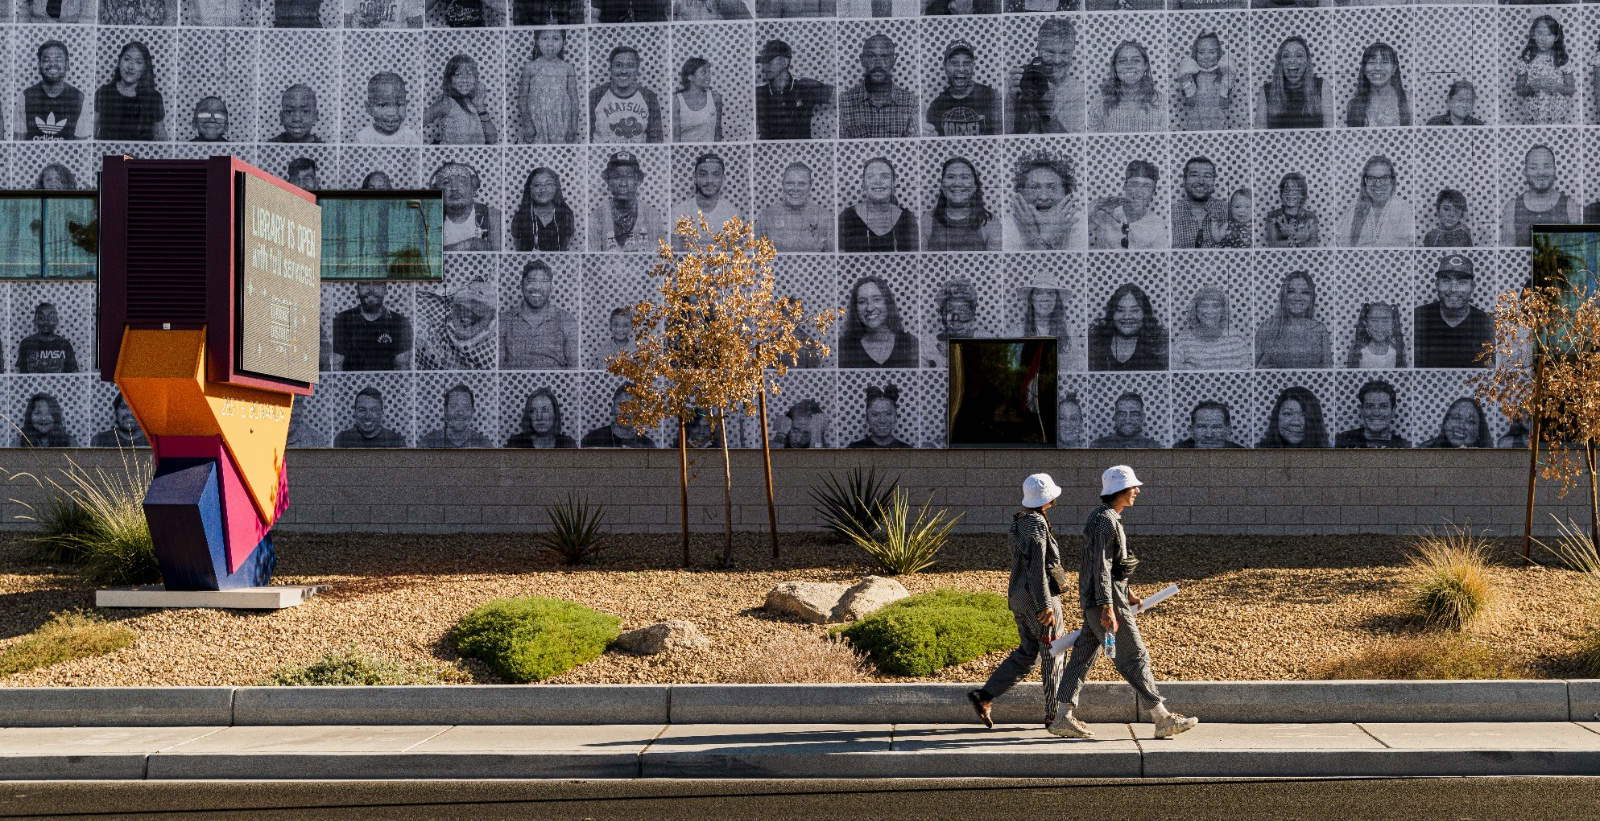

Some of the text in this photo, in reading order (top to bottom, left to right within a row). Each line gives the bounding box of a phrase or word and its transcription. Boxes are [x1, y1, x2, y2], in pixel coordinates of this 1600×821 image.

[252, 205, 316, 259] LIBRARY IS OPEN
[40, 350, 66, 359] NASA
